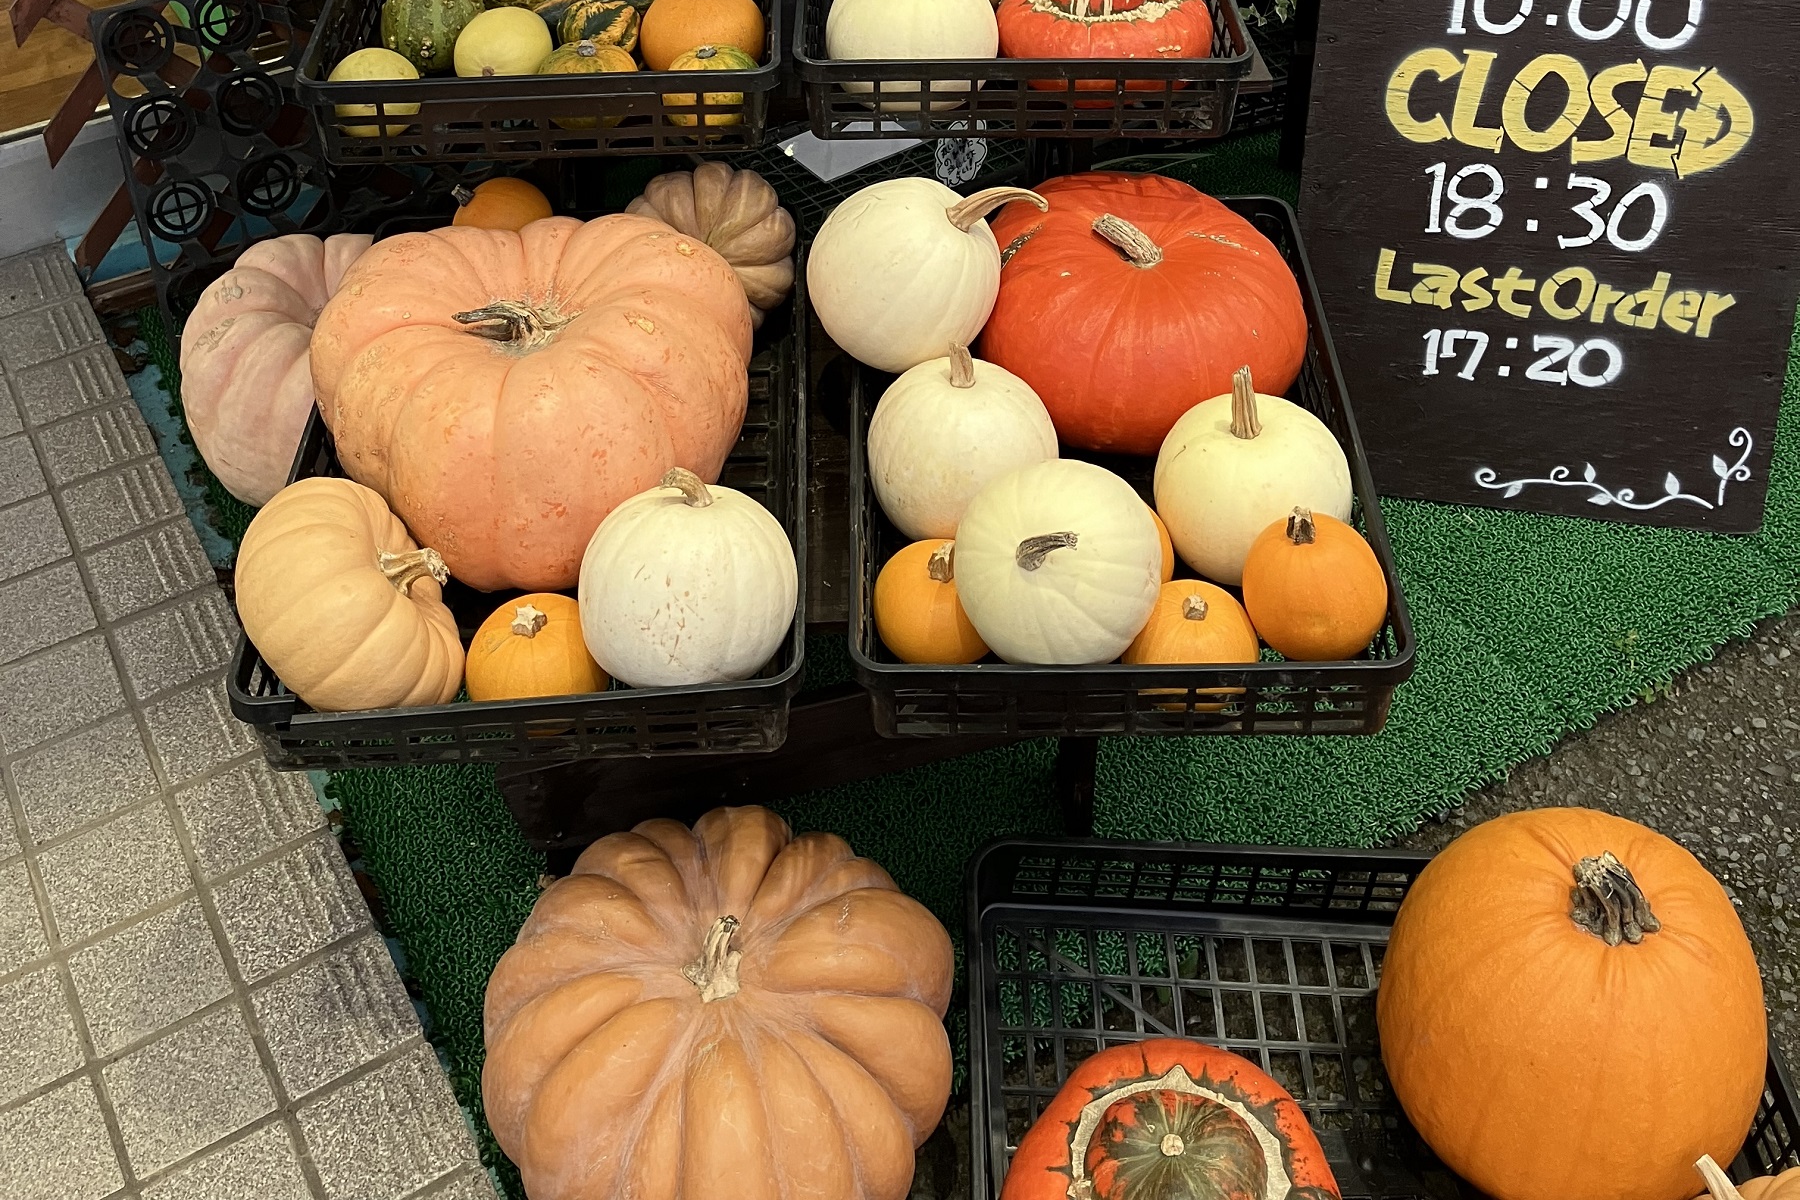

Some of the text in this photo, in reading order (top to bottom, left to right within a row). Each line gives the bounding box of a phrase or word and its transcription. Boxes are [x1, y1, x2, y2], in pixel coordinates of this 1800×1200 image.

[1385, 47, 1755, 180] CLOSED
[1423, 162, 1668, 252] 18:30
[1421, 328, 1623, 388] 17:20
